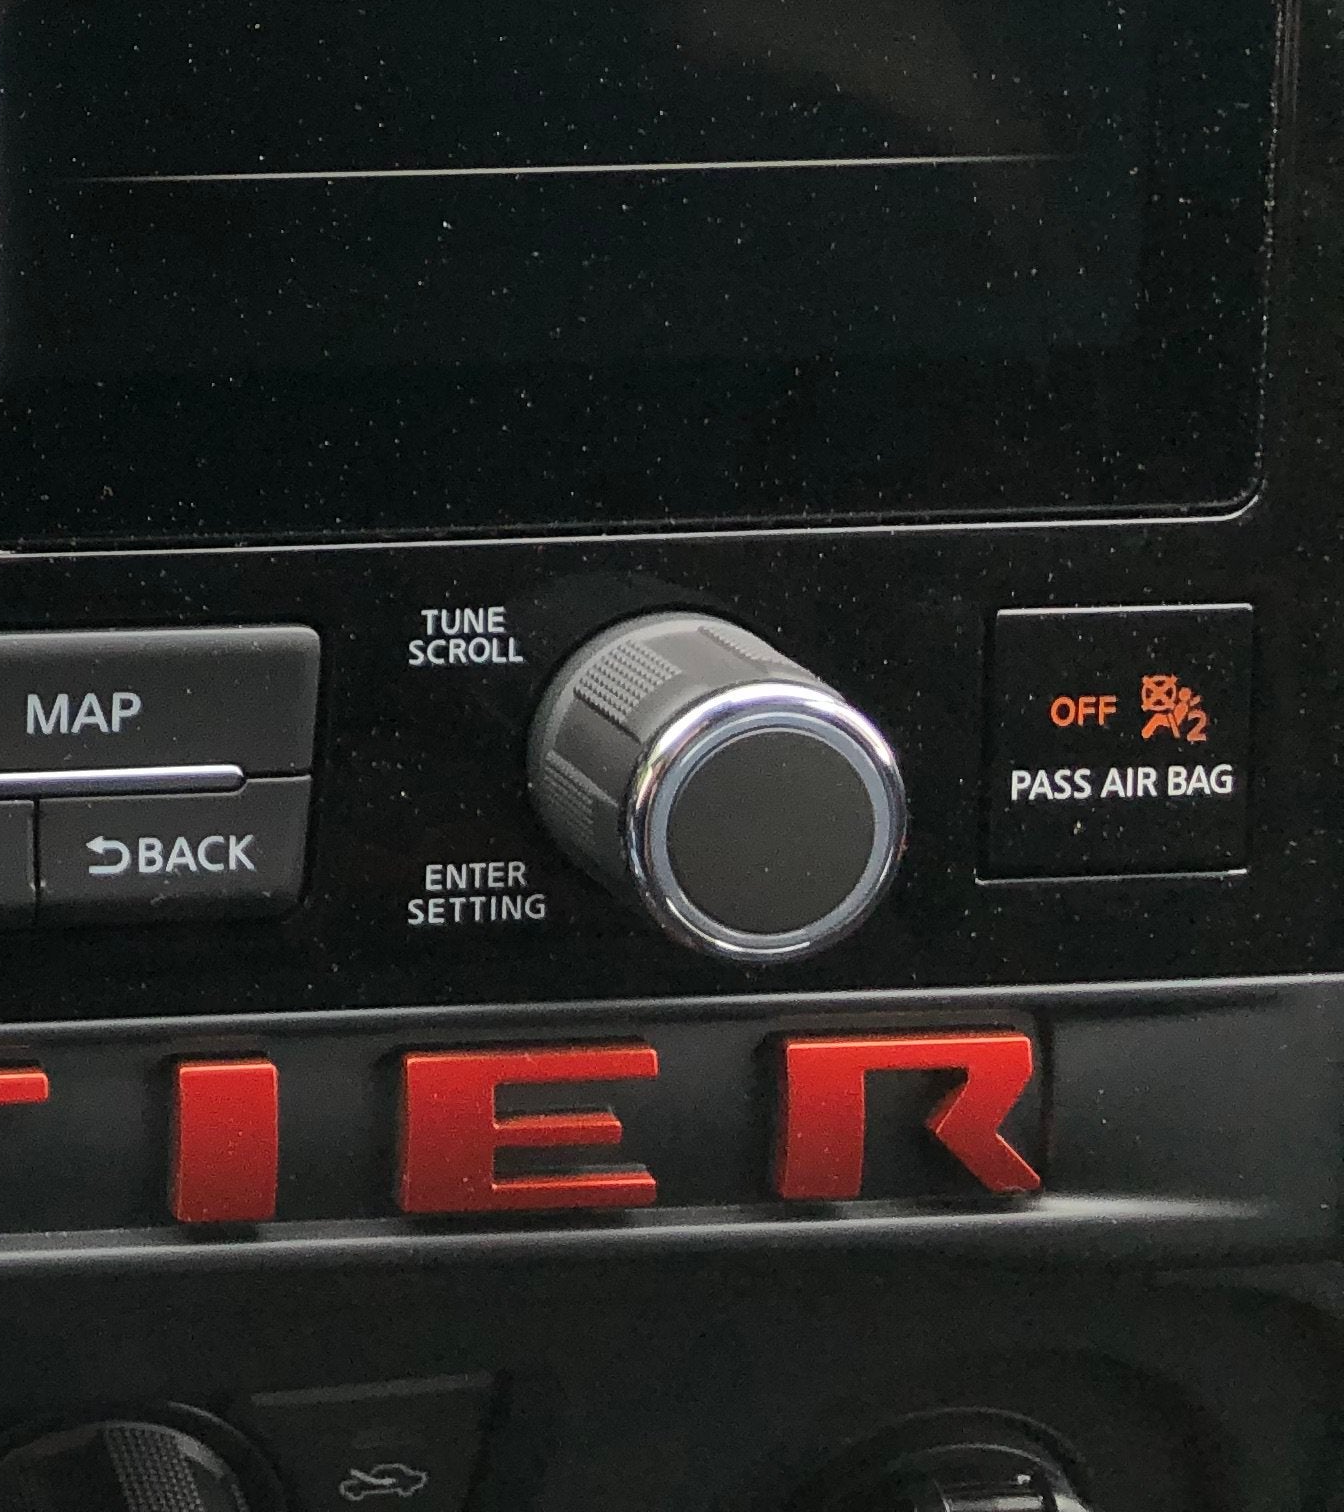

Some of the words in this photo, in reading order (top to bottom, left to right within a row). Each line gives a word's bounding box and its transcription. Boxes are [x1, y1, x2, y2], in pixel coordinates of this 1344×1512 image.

[420, 606, 506, 638] TUNE
[408, 633, 524, 665] SCROLL
[25, 691, 142, 736] MAP
[1051, 694, 1118, 728] OFF
[1010, 769, 1093, 800] PASS
[1100, 768, 1159, 797] AIR
[1166, 764, 1235, 796] BAG
[137, 834, 256, 874] BACK
[424, 862, 528, 892] ENTER
[407, 892, 548, 925] SETTING
